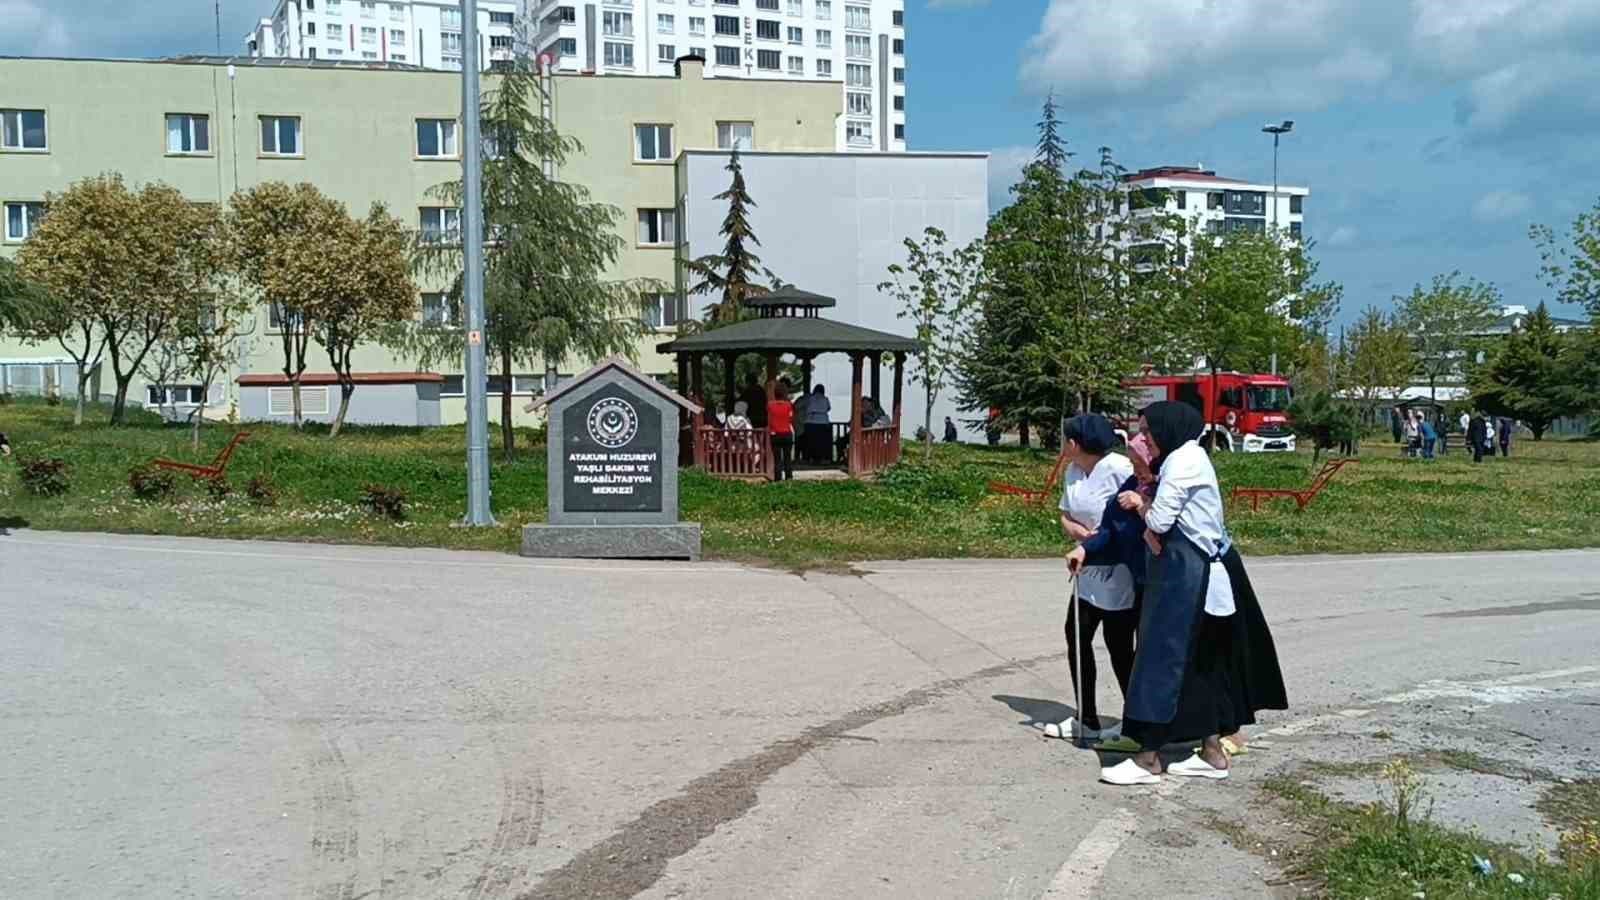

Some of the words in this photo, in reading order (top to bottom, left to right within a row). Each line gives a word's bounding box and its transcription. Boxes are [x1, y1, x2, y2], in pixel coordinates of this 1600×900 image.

[569, 453, 608, 461] ATAKUM
[609, 452, 656, 461] HUZUREVİ
[576, 464, 603, 473] YAŞLI
[605, 464, 635, 472] BAKIM
[636, 464, 649, 472] VE
[573, 474, 652, 483] REHABİLİTASYON
[592, 486, 633, 494] MERKEZİ
